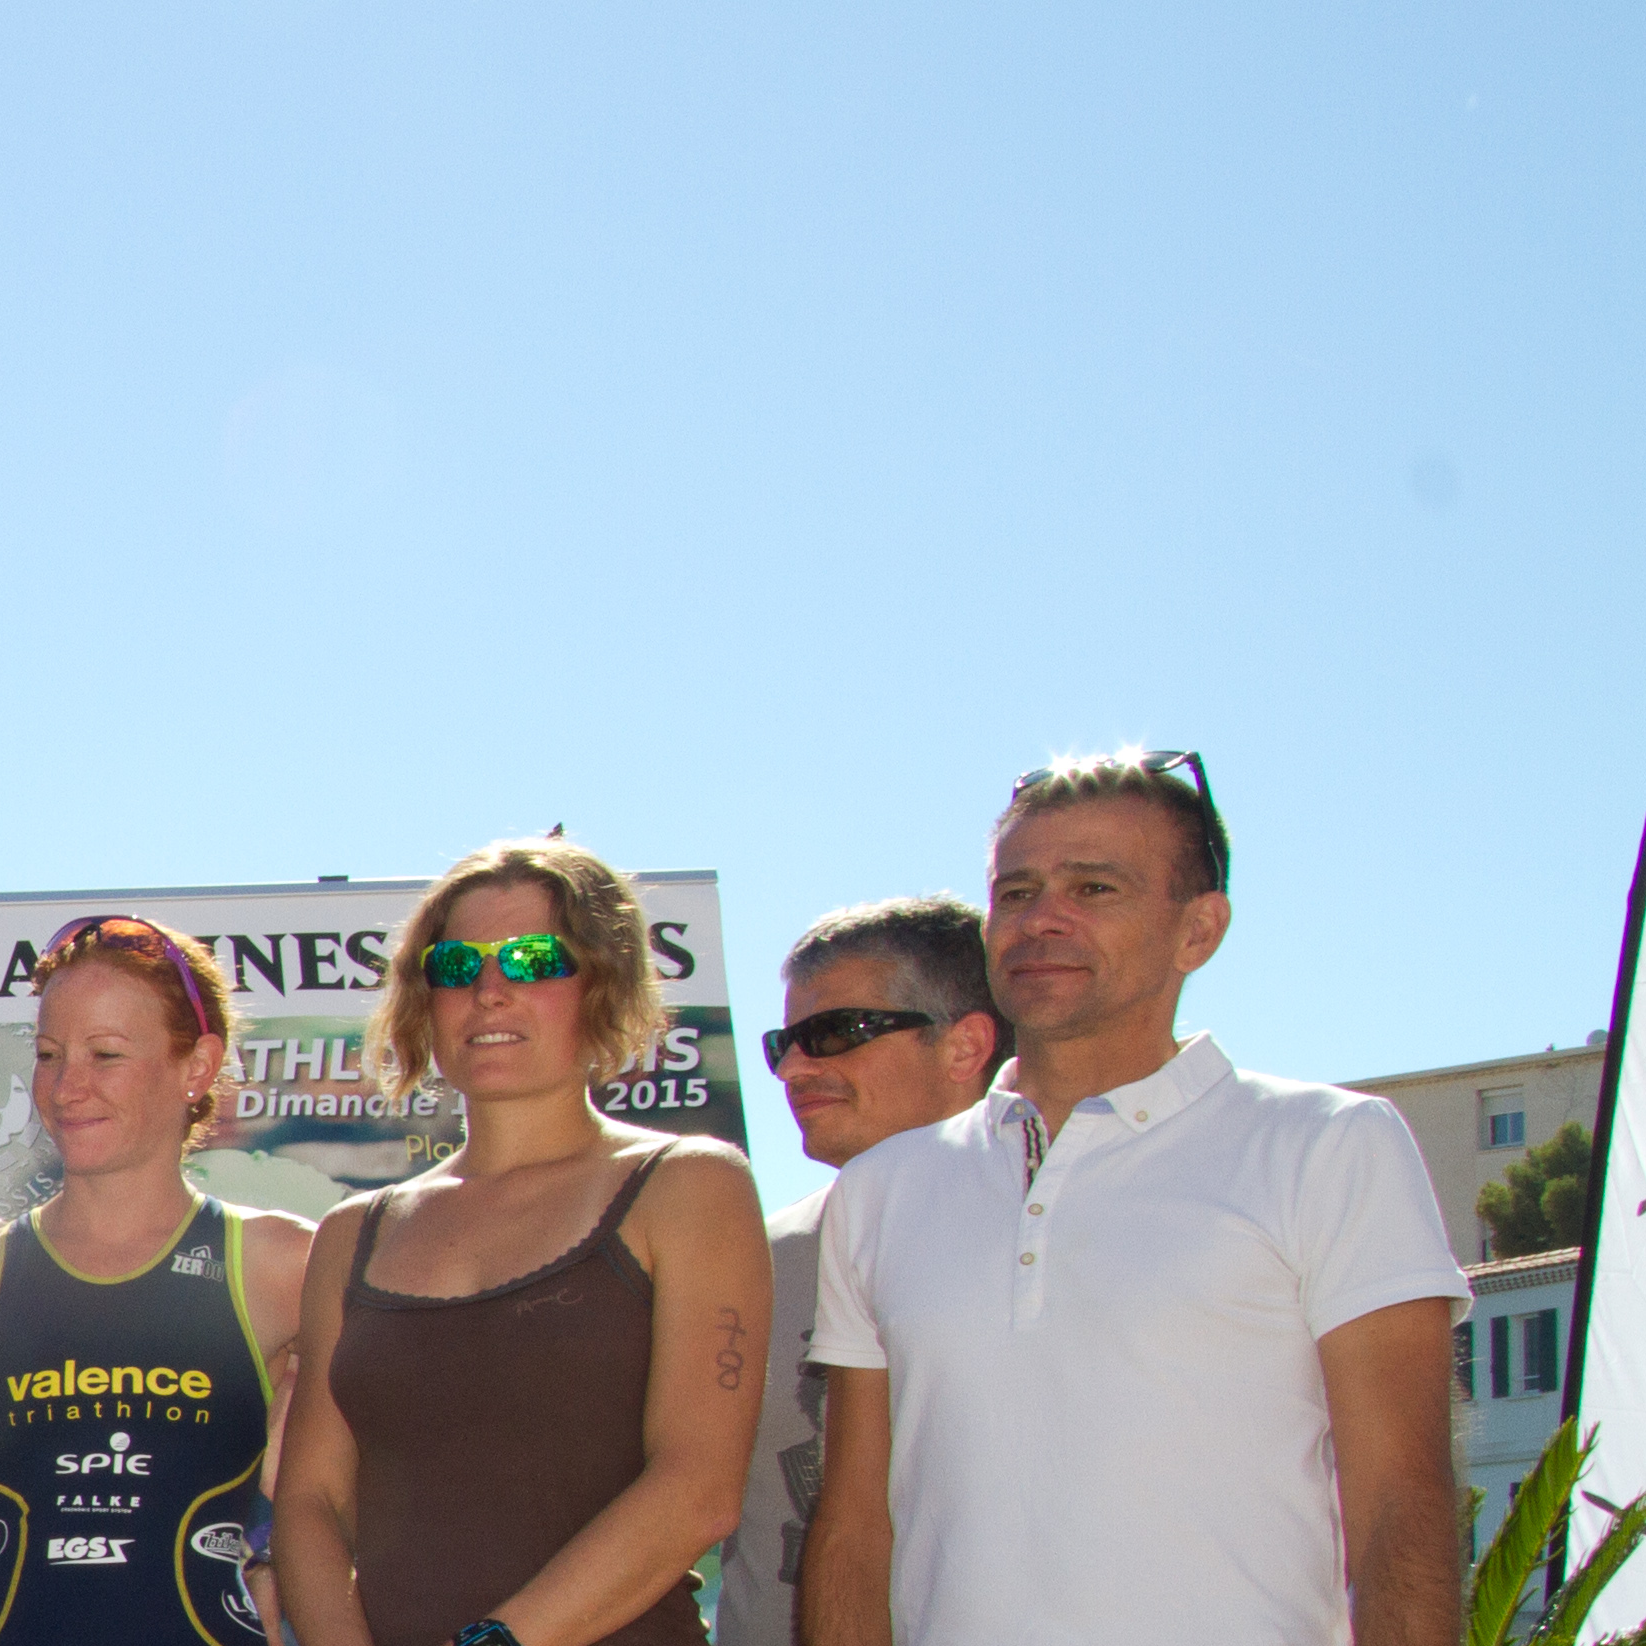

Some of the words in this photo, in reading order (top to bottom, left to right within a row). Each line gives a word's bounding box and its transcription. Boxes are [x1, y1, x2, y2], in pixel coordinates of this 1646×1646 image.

[606, 1077, 708, 1112] 2015
[7, 1360, 212, 1401] valence
[9, 1400, 210, 1428] triathlon
[55, 1453, 153, 1476] SPIE
[56, 1494, 141, 1508] FALKE
